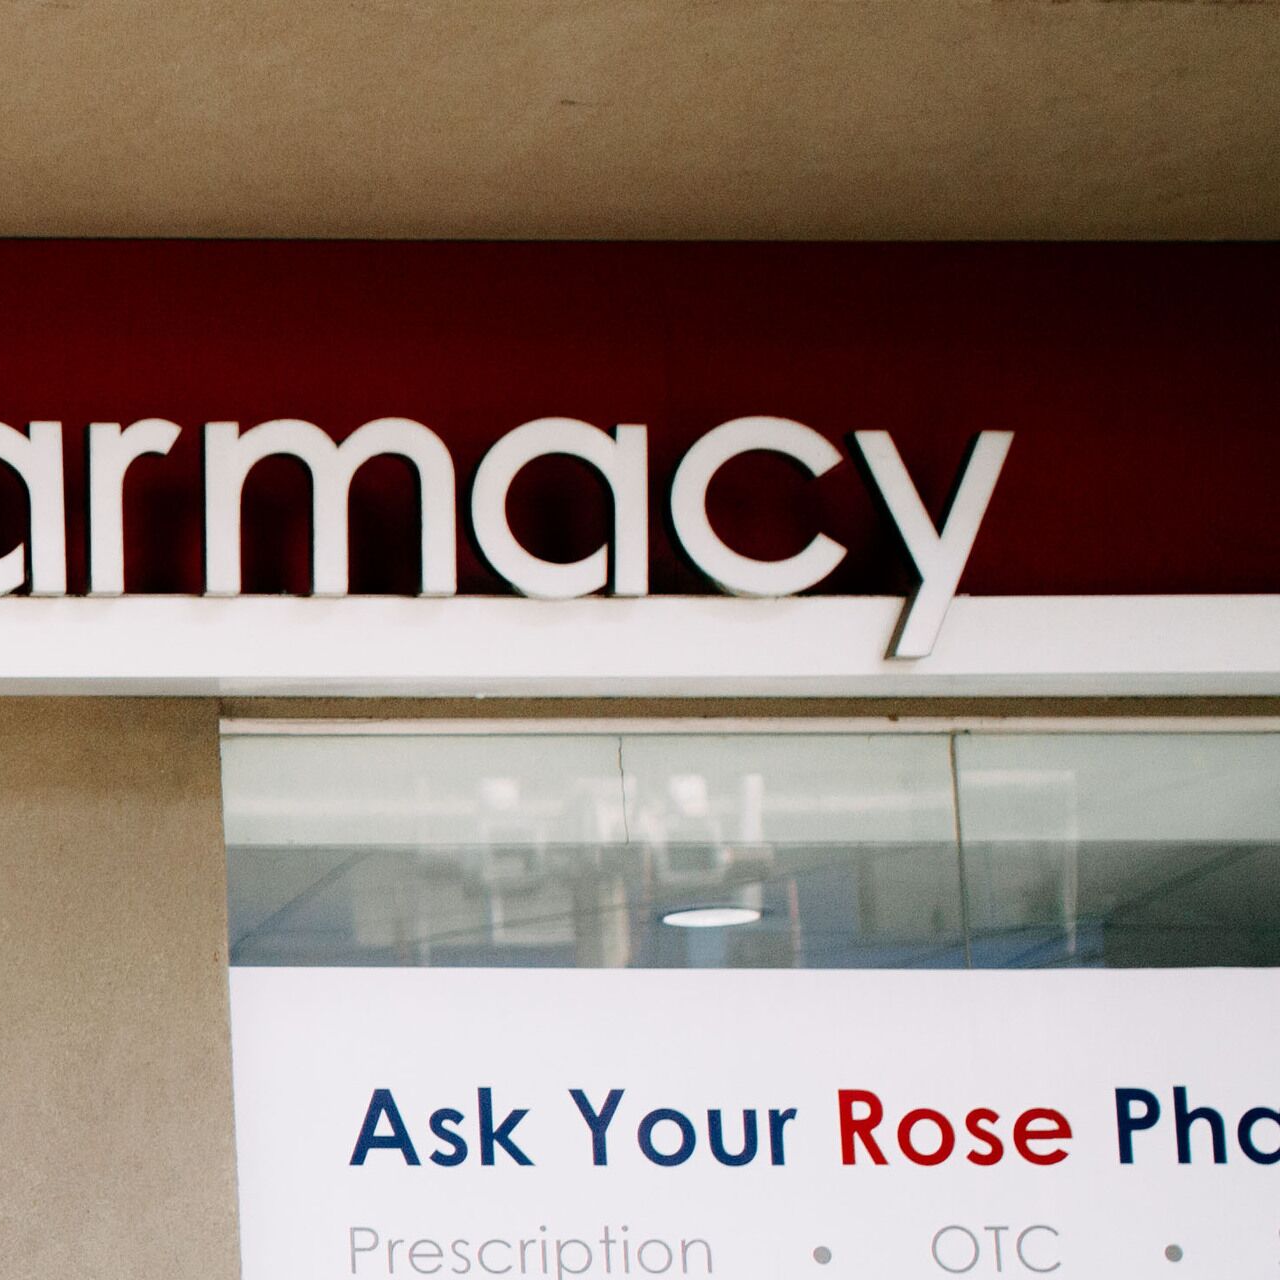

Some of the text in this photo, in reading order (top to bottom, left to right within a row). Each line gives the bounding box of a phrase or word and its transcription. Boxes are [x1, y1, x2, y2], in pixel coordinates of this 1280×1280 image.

[348, 1087, 537, 1167] Ask
[571, 1088, 797, 1168] Your
[838, 1087, 1073, 1167] Rose
[930, 1222, 1062, 1275] OTC
